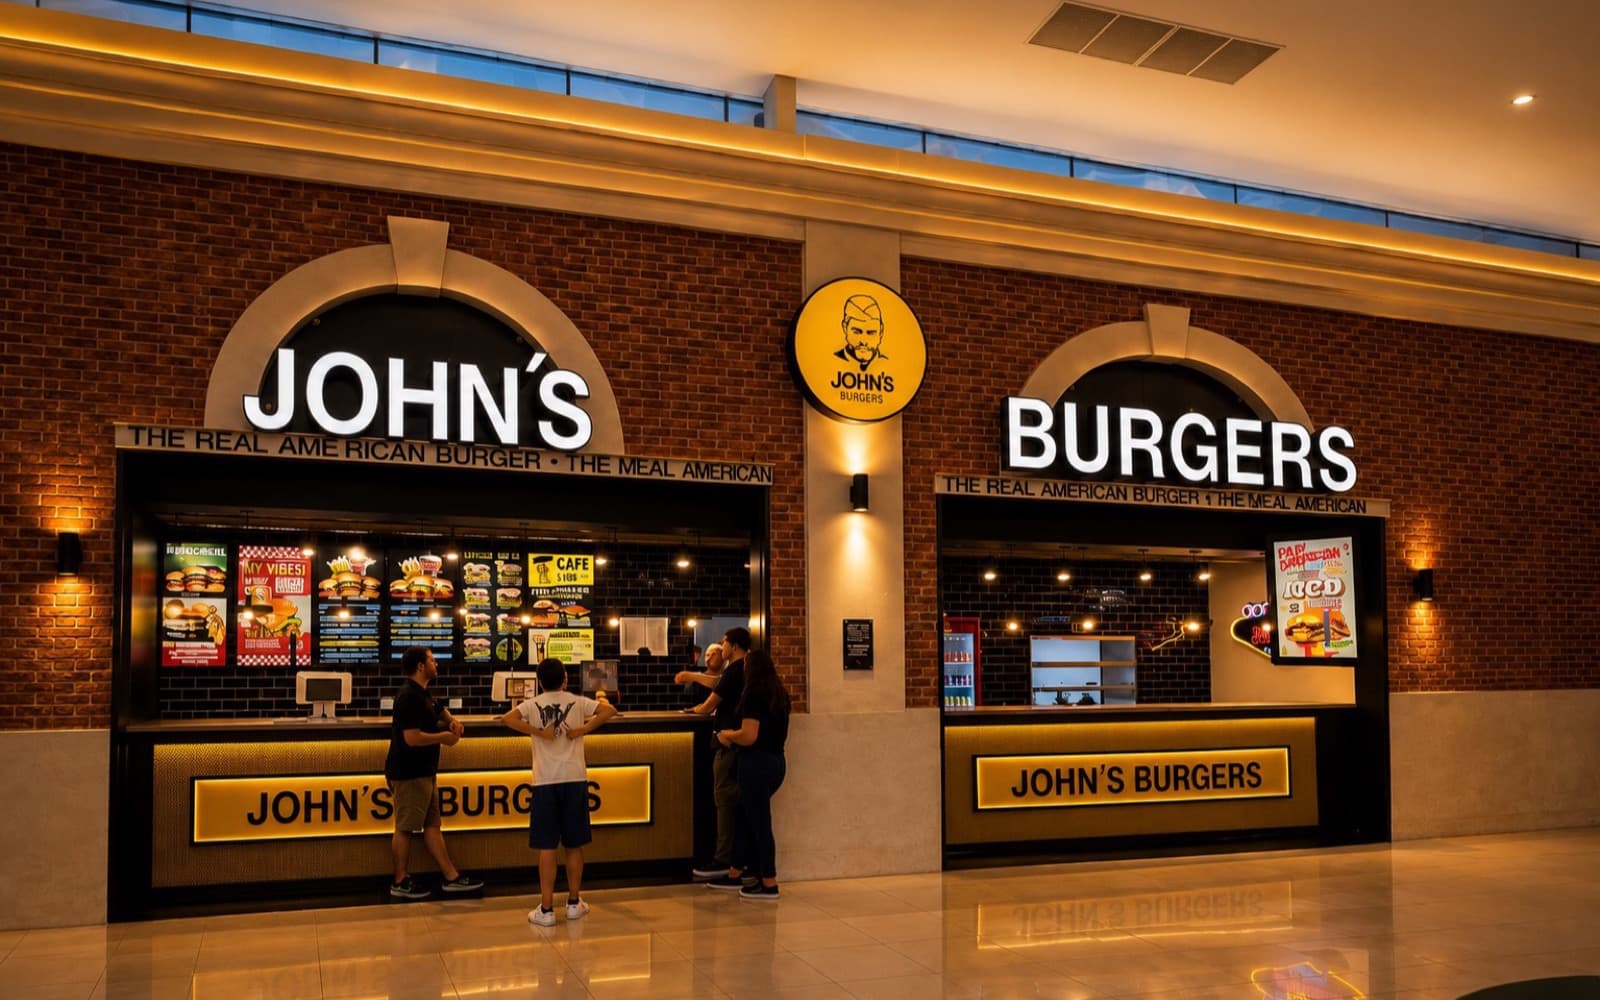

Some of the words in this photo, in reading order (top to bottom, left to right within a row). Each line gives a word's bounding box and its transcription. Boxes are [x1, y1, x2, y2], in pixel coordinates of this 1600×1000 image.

[243, 347, 592, 450] JOHN'S
[831, 371, 894, 392] JOHN'S
[840, 391, 884, 404] BURGERS
[128, 426, 185, 448] THE
[195, 431, 268, 453] REAL
[436, 446, 541, 469] BURGER
[567, 455, 610, 473] THE
[619, 458, 675, 478] MEAL
[682, 462, 772, 482] AMERICAN
[1008, 396, 1357, 492] BURGERS
[944, 476, 981, 493] THE
[987, 479, 1035, 496] REAL
[1041, 481, 1127, 500] AMERICAN
[1133, 487, 1200, 504] BURGER
[1217, 491, 1245, 507] THE
[1250, 494, 1291, 510] MEAL
[1295, 495, 1366, 513] AMERICAN
[557, 557, 588, 571] CAFE
[1011, 764, 1125, 798] JOHN'S
[1134, 761, 1263, 793] BURGERS
[246, 785, 394, 826] JOHN'S
[438, 780, 602, 817] BURGS
